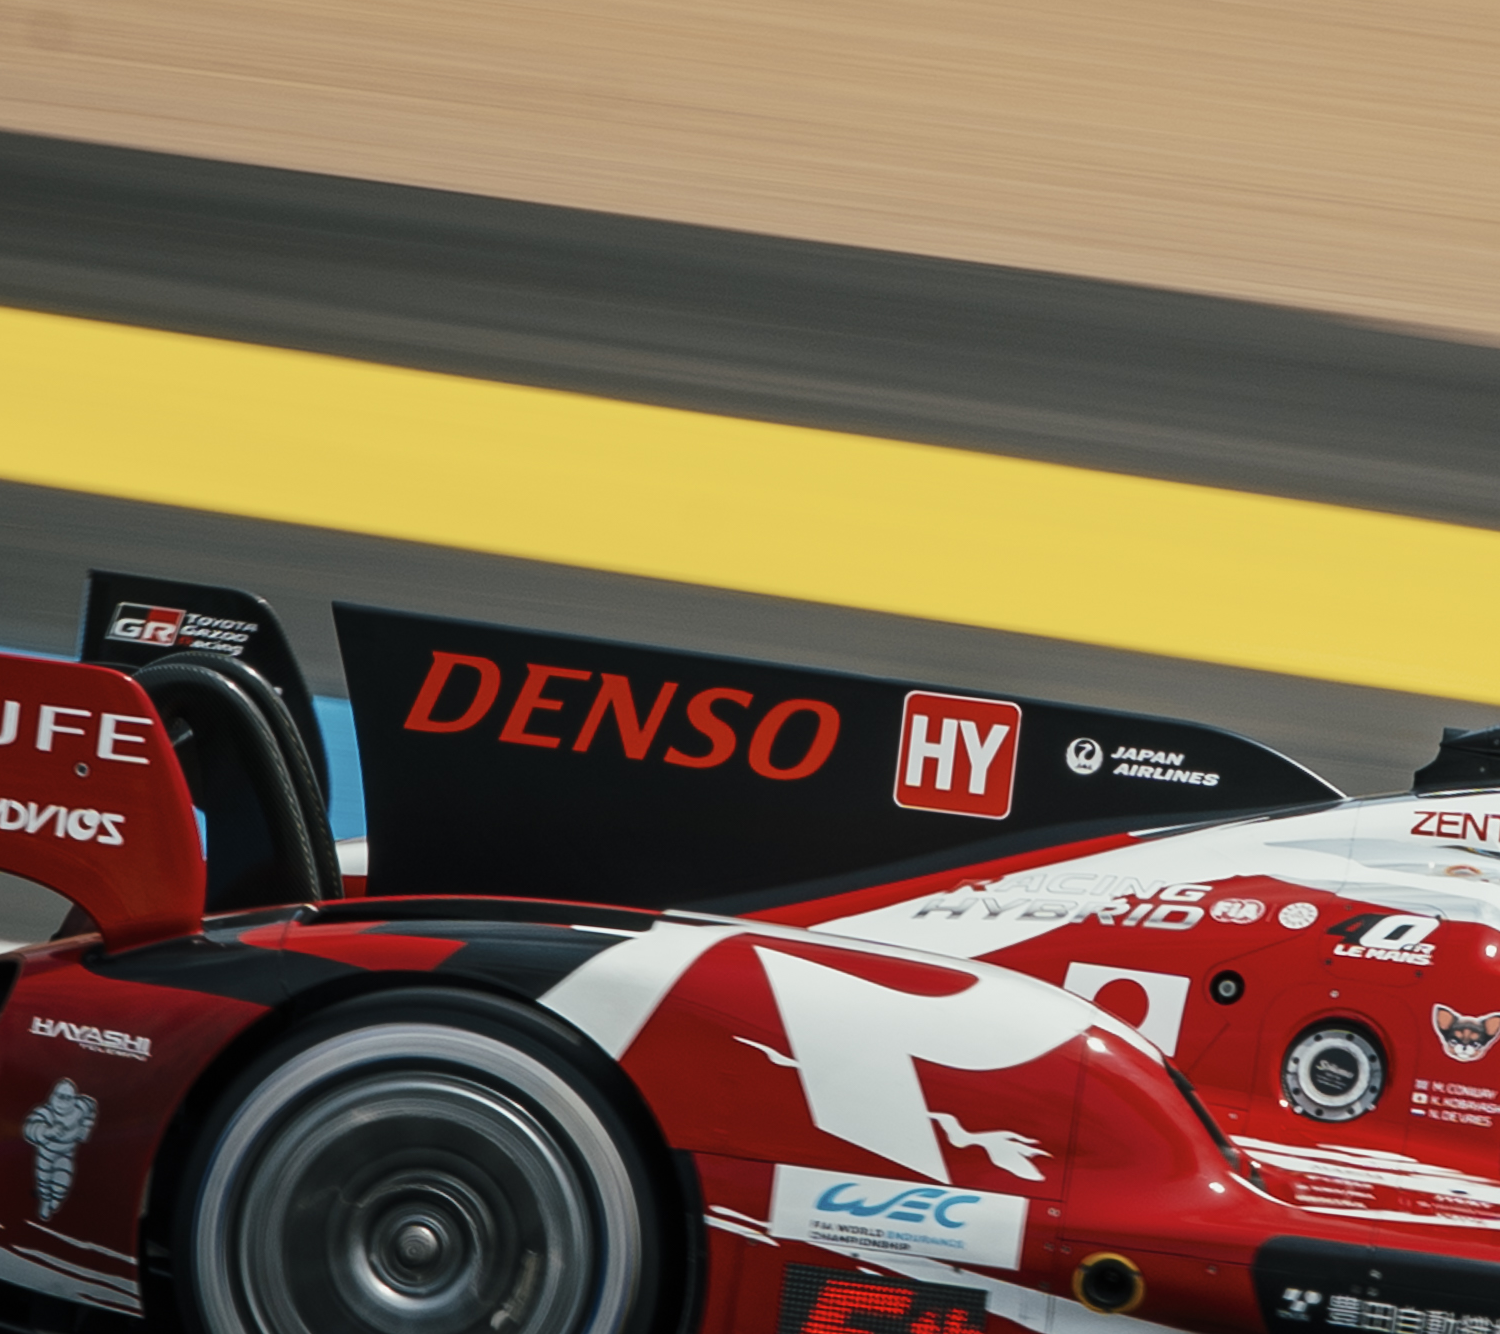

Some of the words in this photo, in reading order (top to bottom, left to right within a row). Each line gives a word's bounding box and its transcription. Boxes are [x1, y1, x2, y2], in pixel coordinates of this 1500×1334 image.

[114, 617, 177, 642] GR
[180, 625, 249, 643] GAZOO
[186, 612, 259, 633] TOYOTA
[403, 651, 841, 780] DENSO
[905, 714, 1011, 795] HY
[1110, 746, 1185, 766] JAPAN
[1112, 763, 1220, 786] AIRLINES
[944, 872, 1214, 903] RACING
[910, 897, 1206, 931] HYBRID
[1212, 899, 1259, 922] FIA
[1333, 944, 1366, 958] LE
[1365, 948, 1434, 967] MANS
[30, 1015, 153, 1054] HAYASHI
[815, 1181, 981, 1229] WEC
